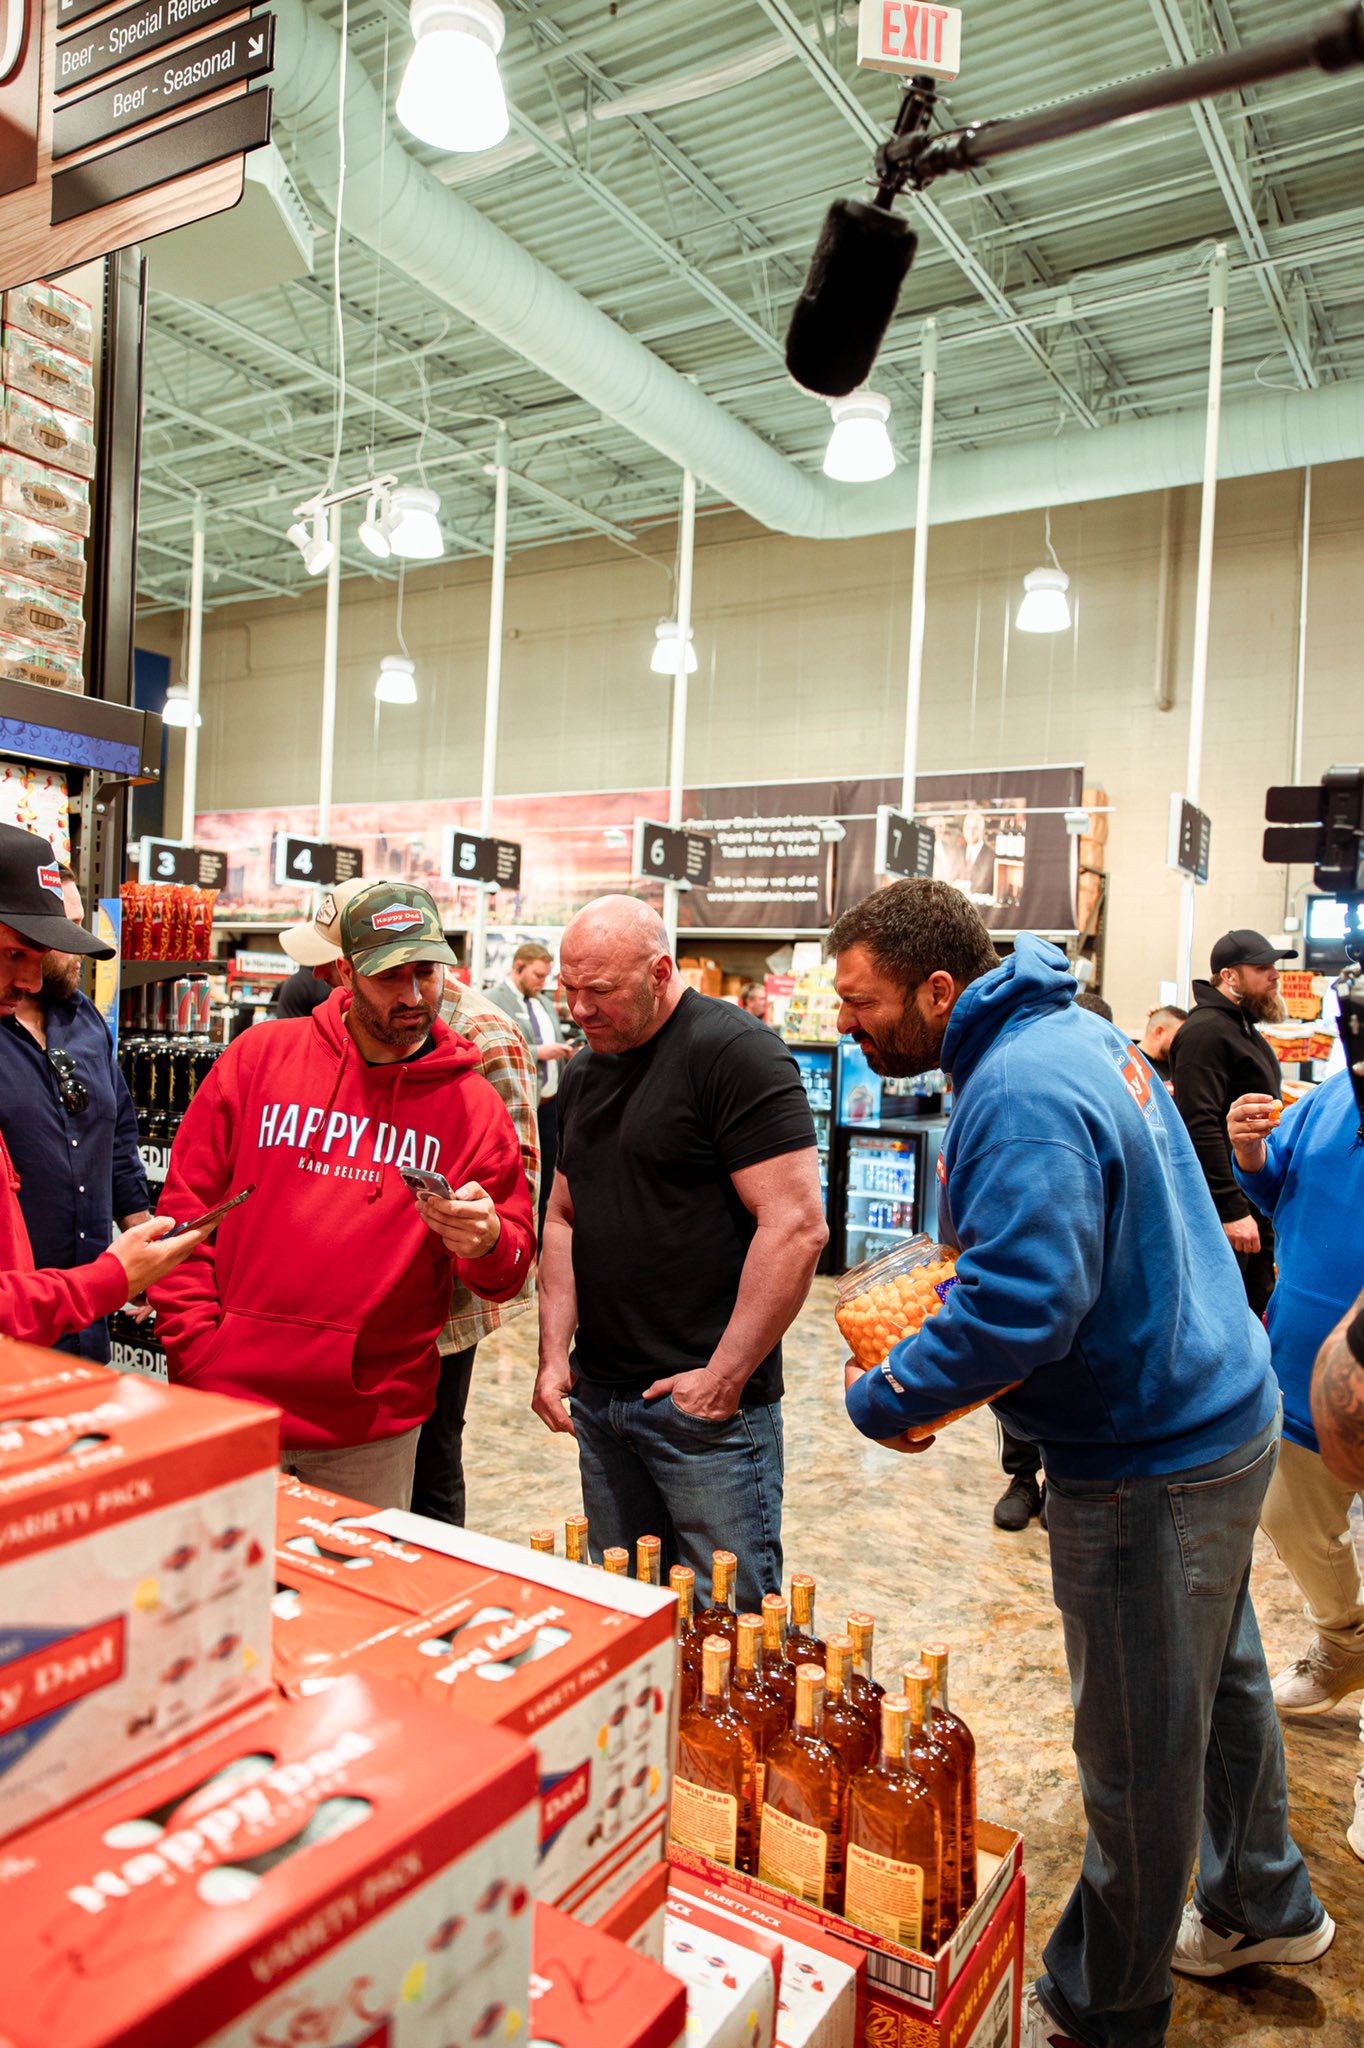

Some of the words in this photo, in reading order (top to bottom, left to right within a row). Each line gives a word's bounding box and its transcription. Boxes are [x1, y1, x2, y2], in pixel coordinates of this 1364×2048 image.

[61, 45, 95, 76] Beer
[109, 6, 163, 54] Special
[167, 0, 219, 25] Relea
[881, 0, 948, 63] EXIT
[113, 86, 148, 118] Beer
[163, 42, 236, 96] Seasonal
[459, 841, 477, 871] 5
[650, 837, 666, 866] 6
[747, 845, 775, 857] Wine
[893, 828, 903, 859] 7
[156, 850, 176, 876] 3
[292, 848, 313, 875] 4
[375, 914, 404, 924] Happy
[257, 1103, 371, 1158] HAPPY
[372, 1121, 441, 1174] DAD
[95, 1477, 154, 1516] PACK
[34, 1635, 114, 1696] Dad
[543, 1775, 587, 1824] Dad
[706, 1793, 730, 1805] HEAD
[795, 1825, 820, 1839] HEAD
[851, 1847, 887, 1868] HOWLER
[889, 1863, 917, 1876] HEAD
[703, 1888, 751, 1913] VARIETY
[750, 1909, 782, 1928] PACK
[949, 1967, 990, 2048] HOWLER
[992, 1920, 1016, 1973] HEAD
